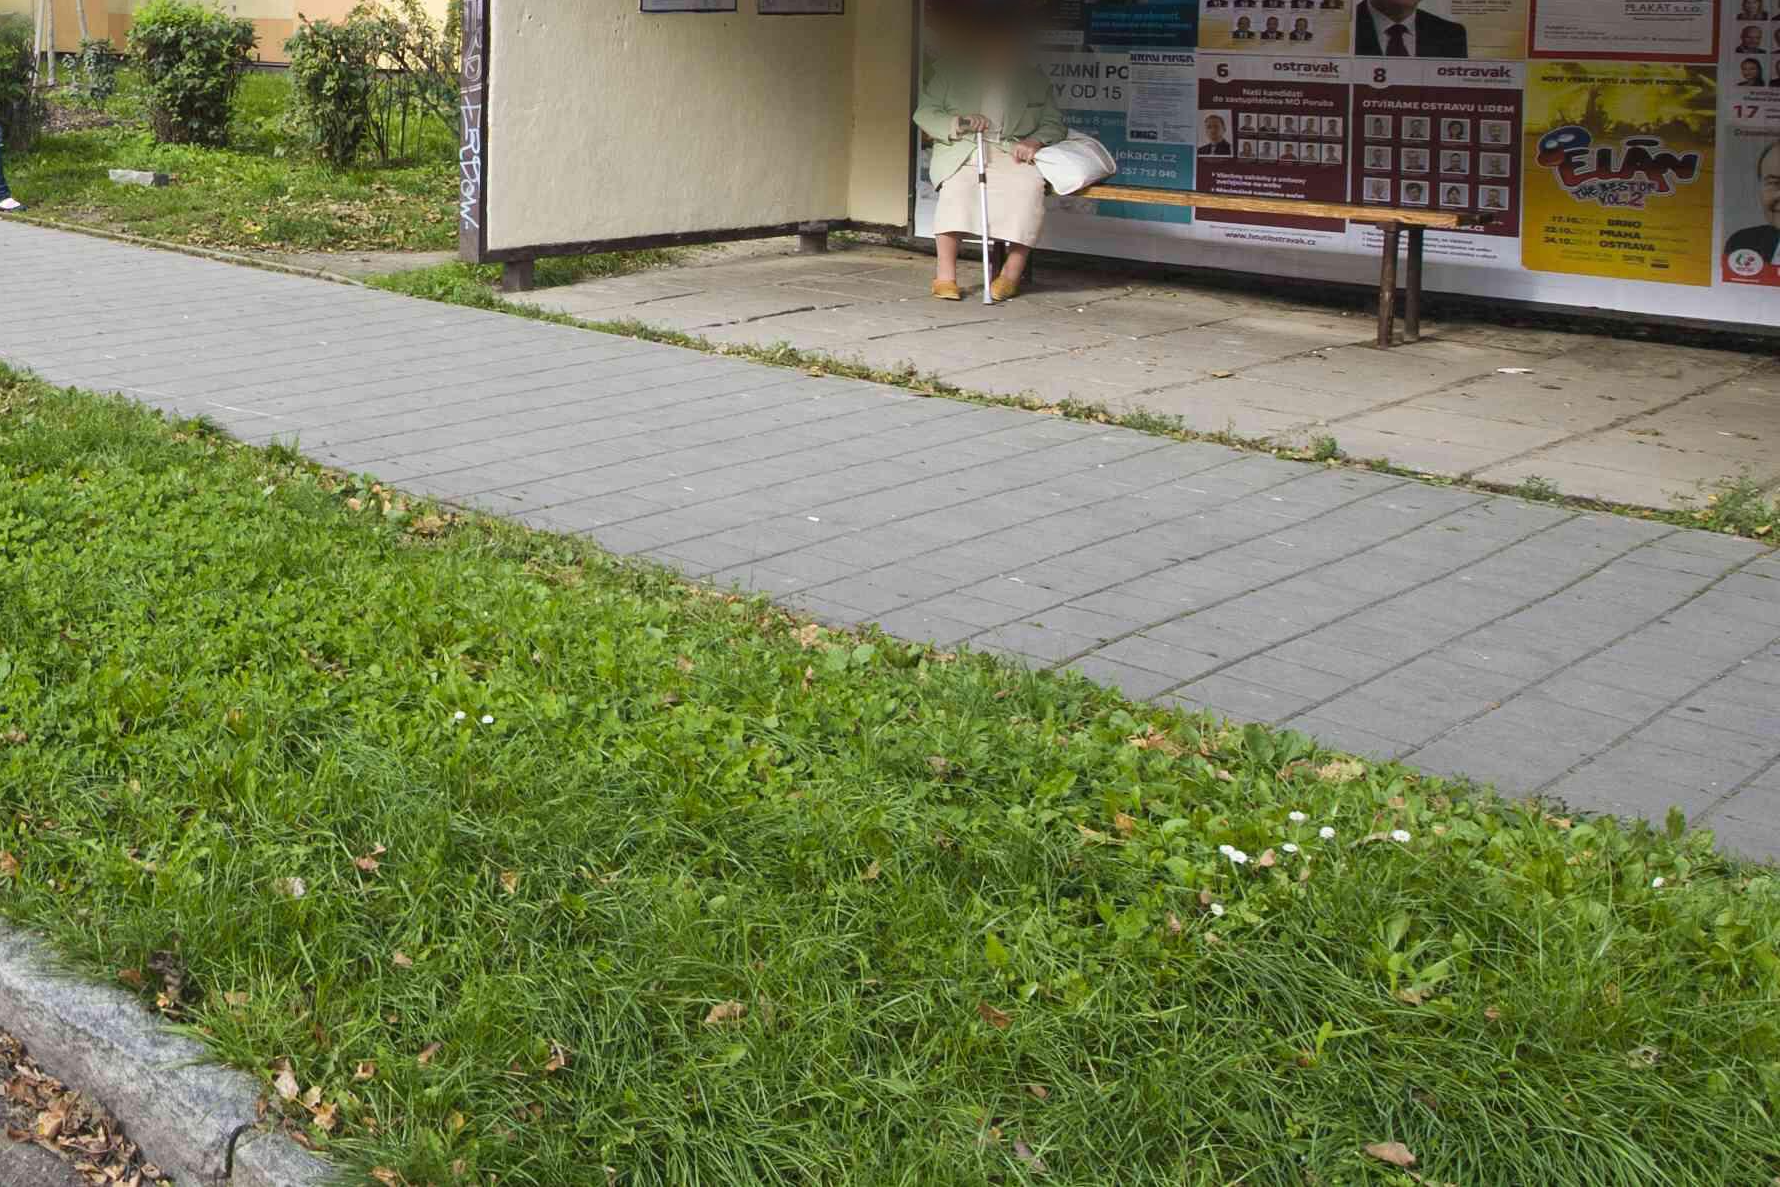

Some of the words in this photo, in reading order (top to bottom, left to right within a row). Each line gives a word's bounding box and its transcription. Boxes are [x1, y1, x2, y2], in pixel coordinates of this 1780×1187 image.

[1049, 63, 1100, 79] ZIMNÍ
[1217, 63, 1229, 77] 6
[1273, 62, 1339, 74] ostravak
[1437, 66, 1511, 78] ostravak
[1373, 68, 1386, 83] 8
[1071, 84, 1097, 99] OD
[1421, 102, 1475, 112] OSTRAVU
[1477, 104, 1515, 114] LIDEM
[1733, 104, 1759, 118] 17
